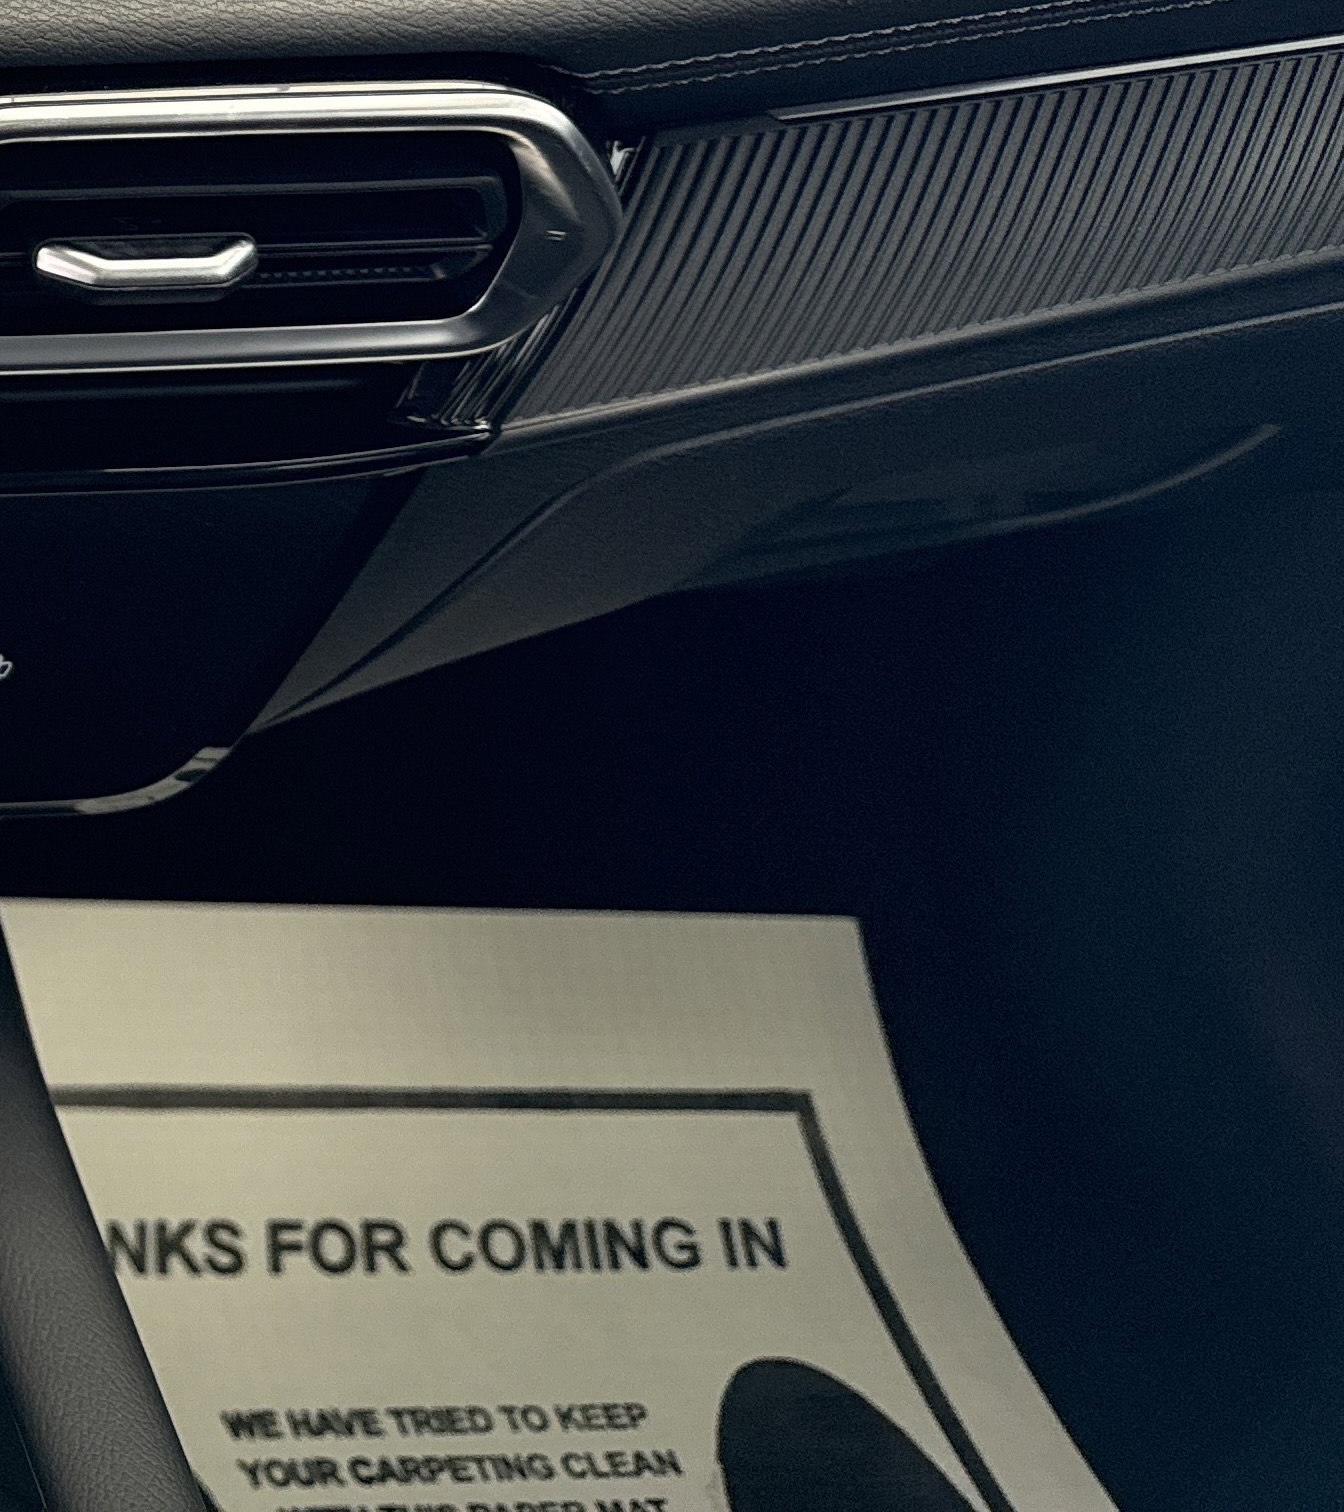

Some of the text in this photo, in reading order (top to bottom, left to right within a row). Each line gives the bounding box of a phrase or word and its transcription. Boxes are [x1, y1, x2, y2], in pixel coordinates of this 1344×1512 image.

[109, 1216, 788, 1276] NKS FOR COMING IN
[220, 1402, 649, 1441] WE HAVE TRIED TO KEEP
[237, 1448, 685, 1489] YOUR CARPETING CLEAN
